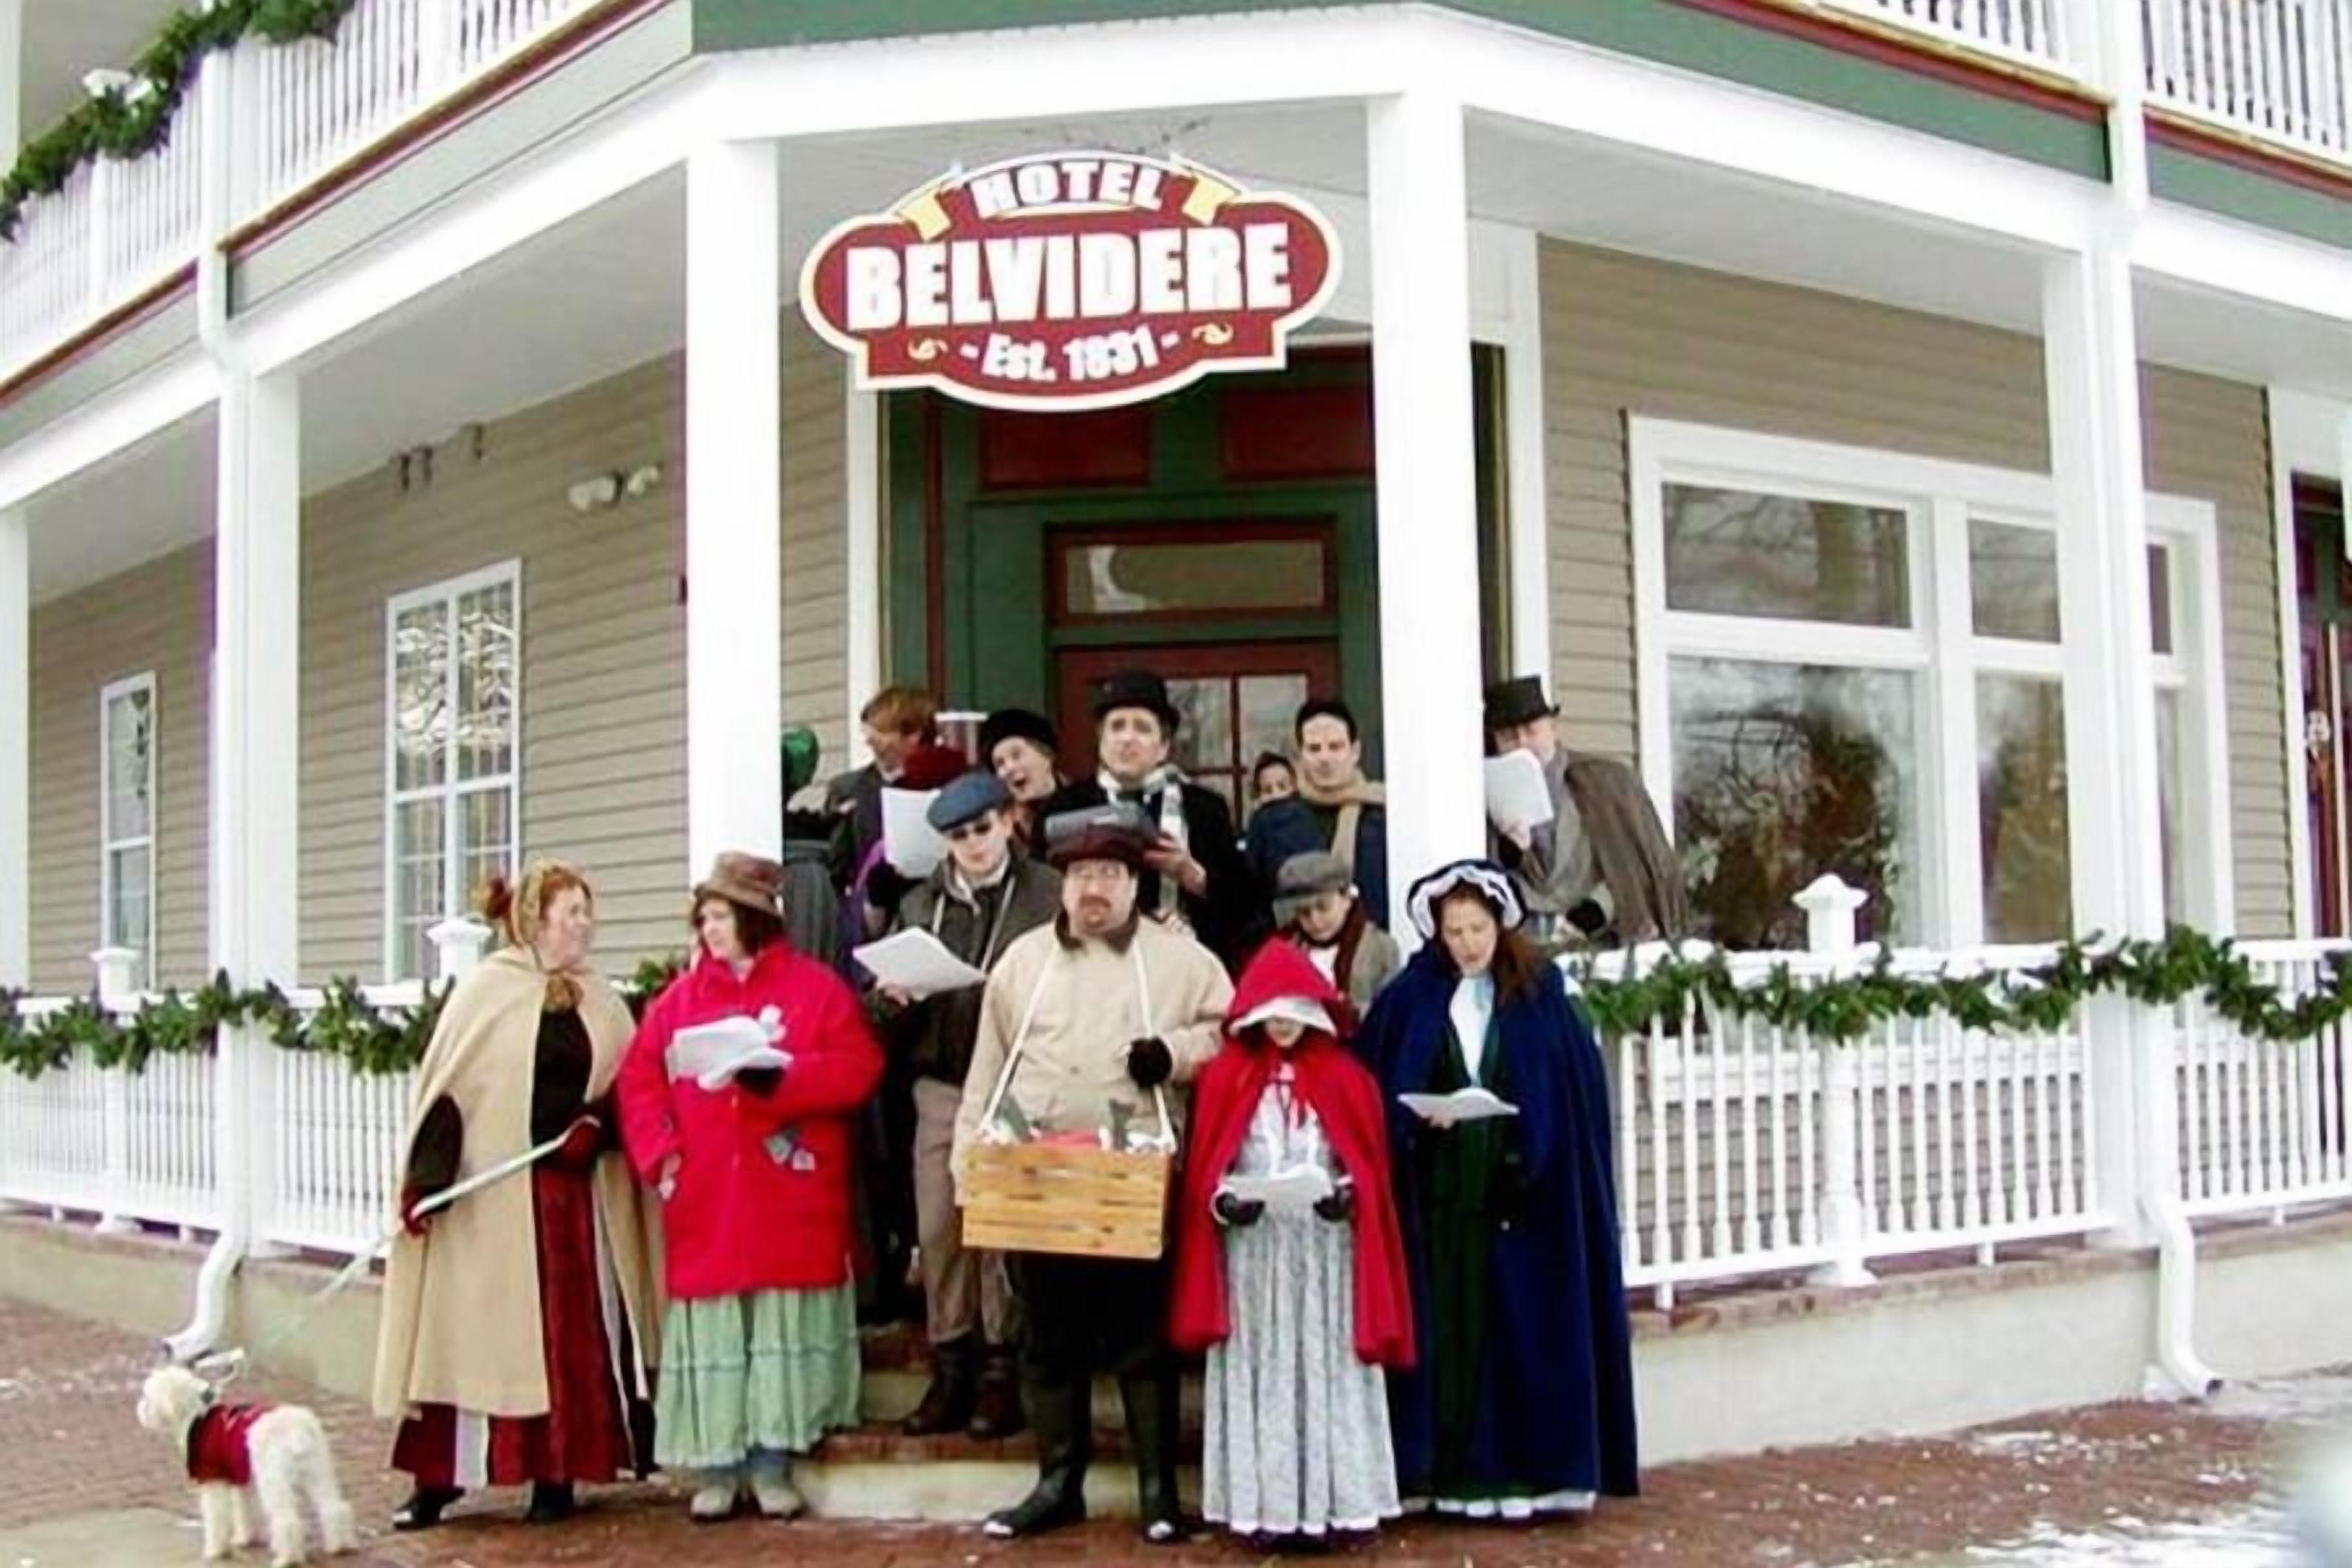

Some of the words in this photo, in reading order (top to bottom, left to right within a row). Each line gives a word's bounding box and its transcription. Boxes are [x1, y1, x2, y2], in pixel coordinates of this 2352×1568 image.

[970, 162, 1164, 218] HOTEL
[845, 223, 1292, 330] BELVIDERE
[981, 334, 1055, 380] Est.
